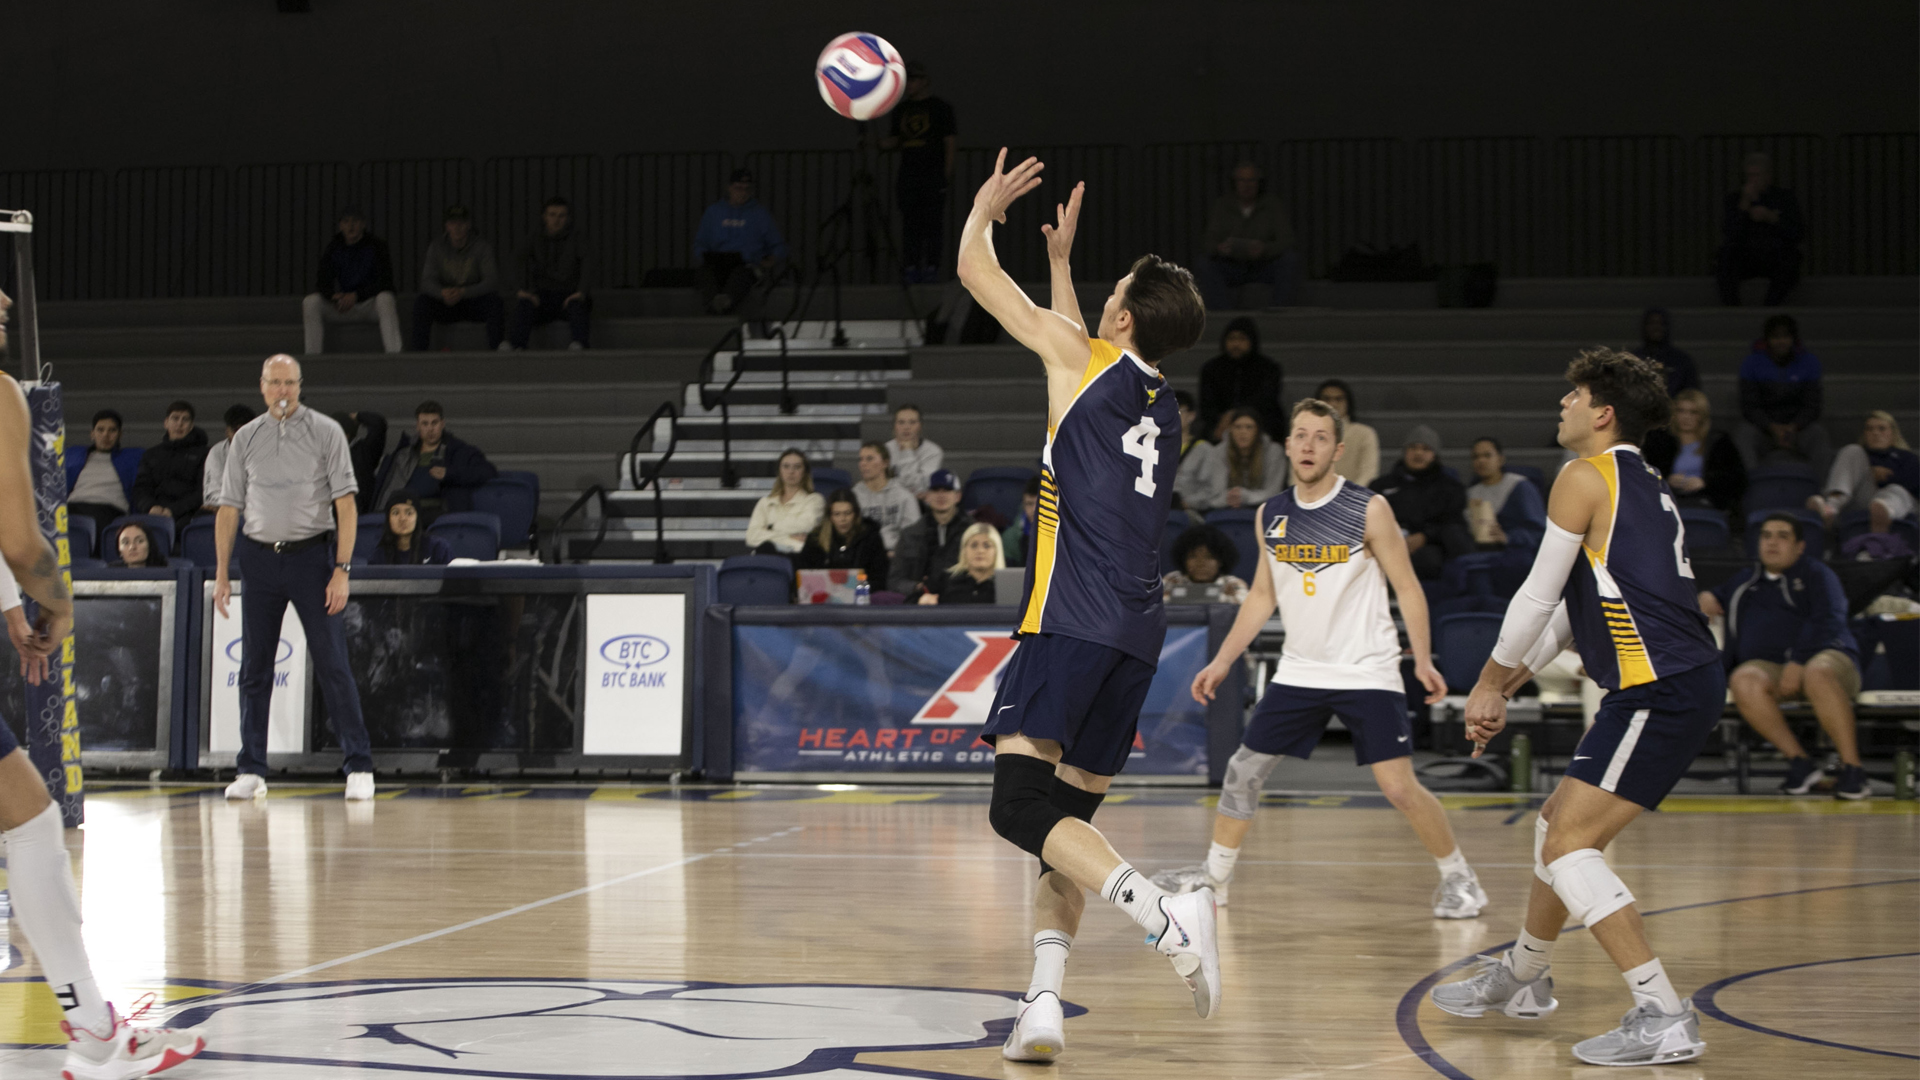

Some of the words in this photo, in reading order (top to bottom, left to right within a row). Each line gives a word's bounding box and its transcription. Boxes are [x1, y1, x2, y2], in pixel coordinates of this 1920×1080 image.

[1121, 415, 1161, 498] 4
[1659, 492, 1695, 579] 2
[1275, 544, 1350, 563] GRACELAND
[1303, 571, 1316, 597] 6
[54, 505, 83, 794] GRELAND
[619, 641, 652, 659] BTC
[601, 671, 627, 688] BTC
[629, 671, 667, 688] BANK
[798, 728, 923, 749] HEART
[929, 728, 967, 745] OF
[844, 751, 944, 762] ATHLETIC
